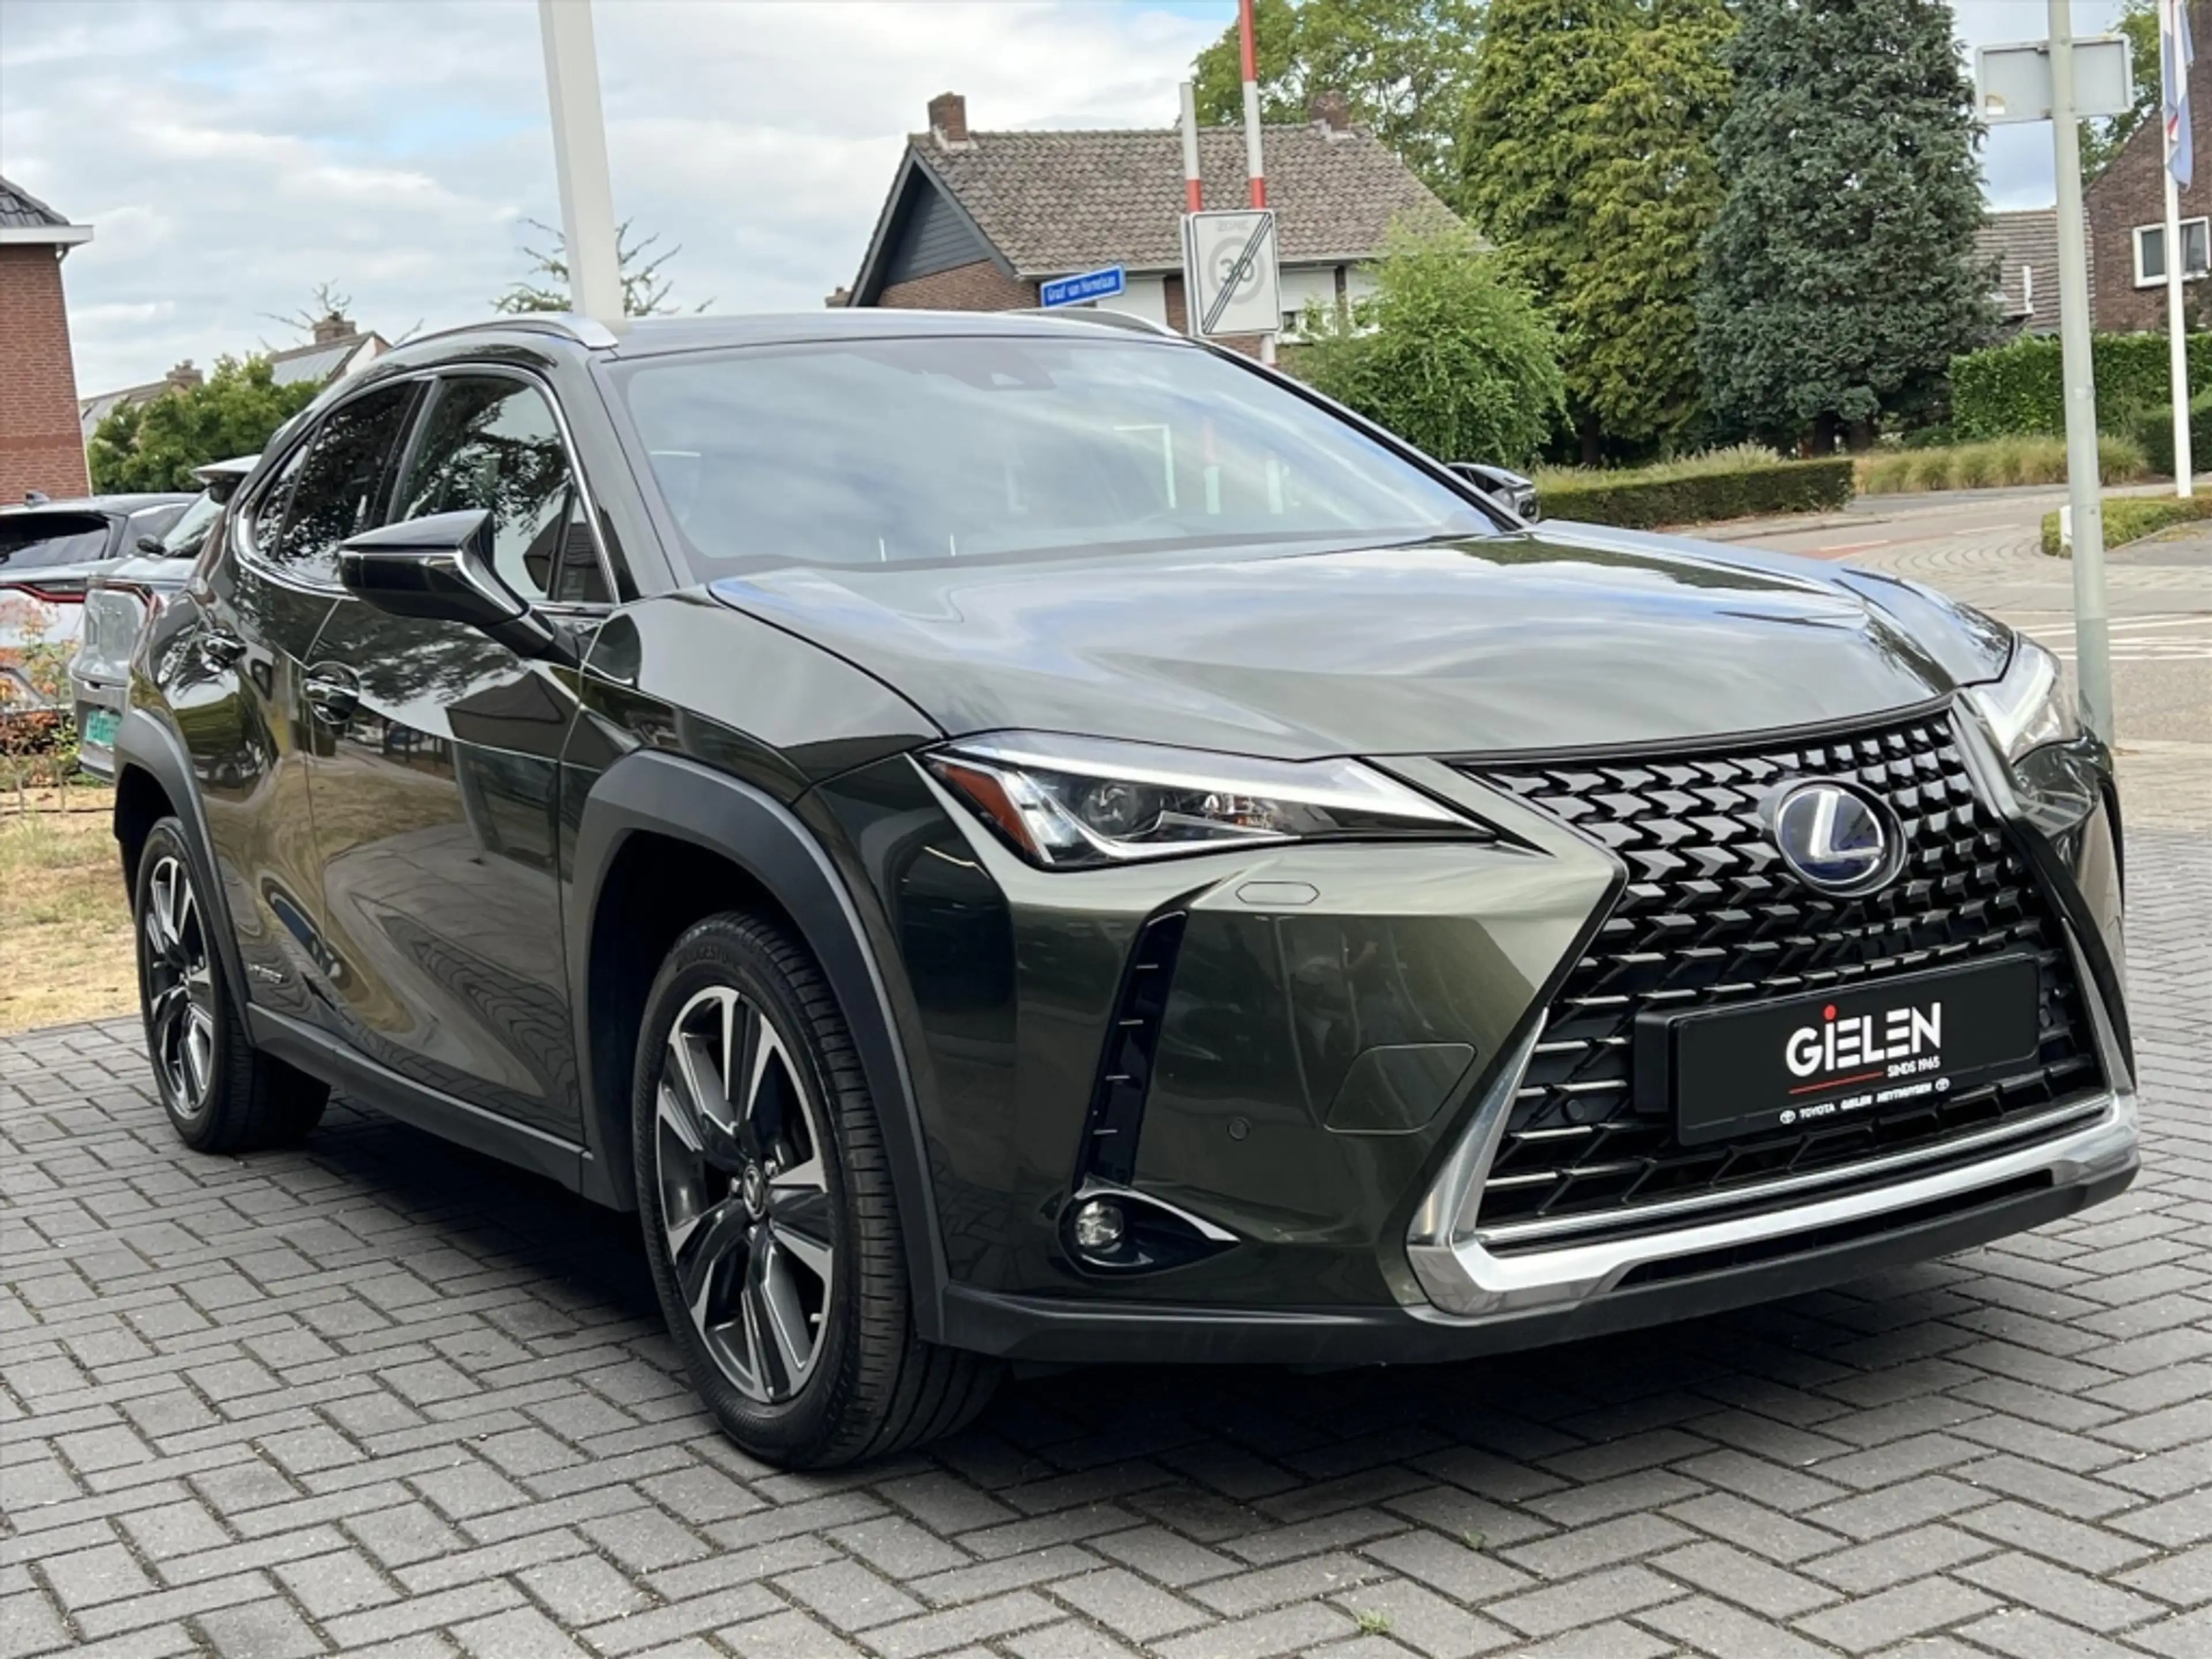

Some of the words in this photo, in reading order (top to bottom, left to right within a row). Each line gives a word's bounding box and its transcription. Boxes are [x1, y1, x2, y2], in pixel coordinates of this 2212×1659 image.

[1218, 257, 1255, 283] 30
[1887, 1060, 1916, 1078] SINDS
[1918, 1054, 1941, 1072] 1965
[1799, 1102, 1835, 1119] TOYOTA
